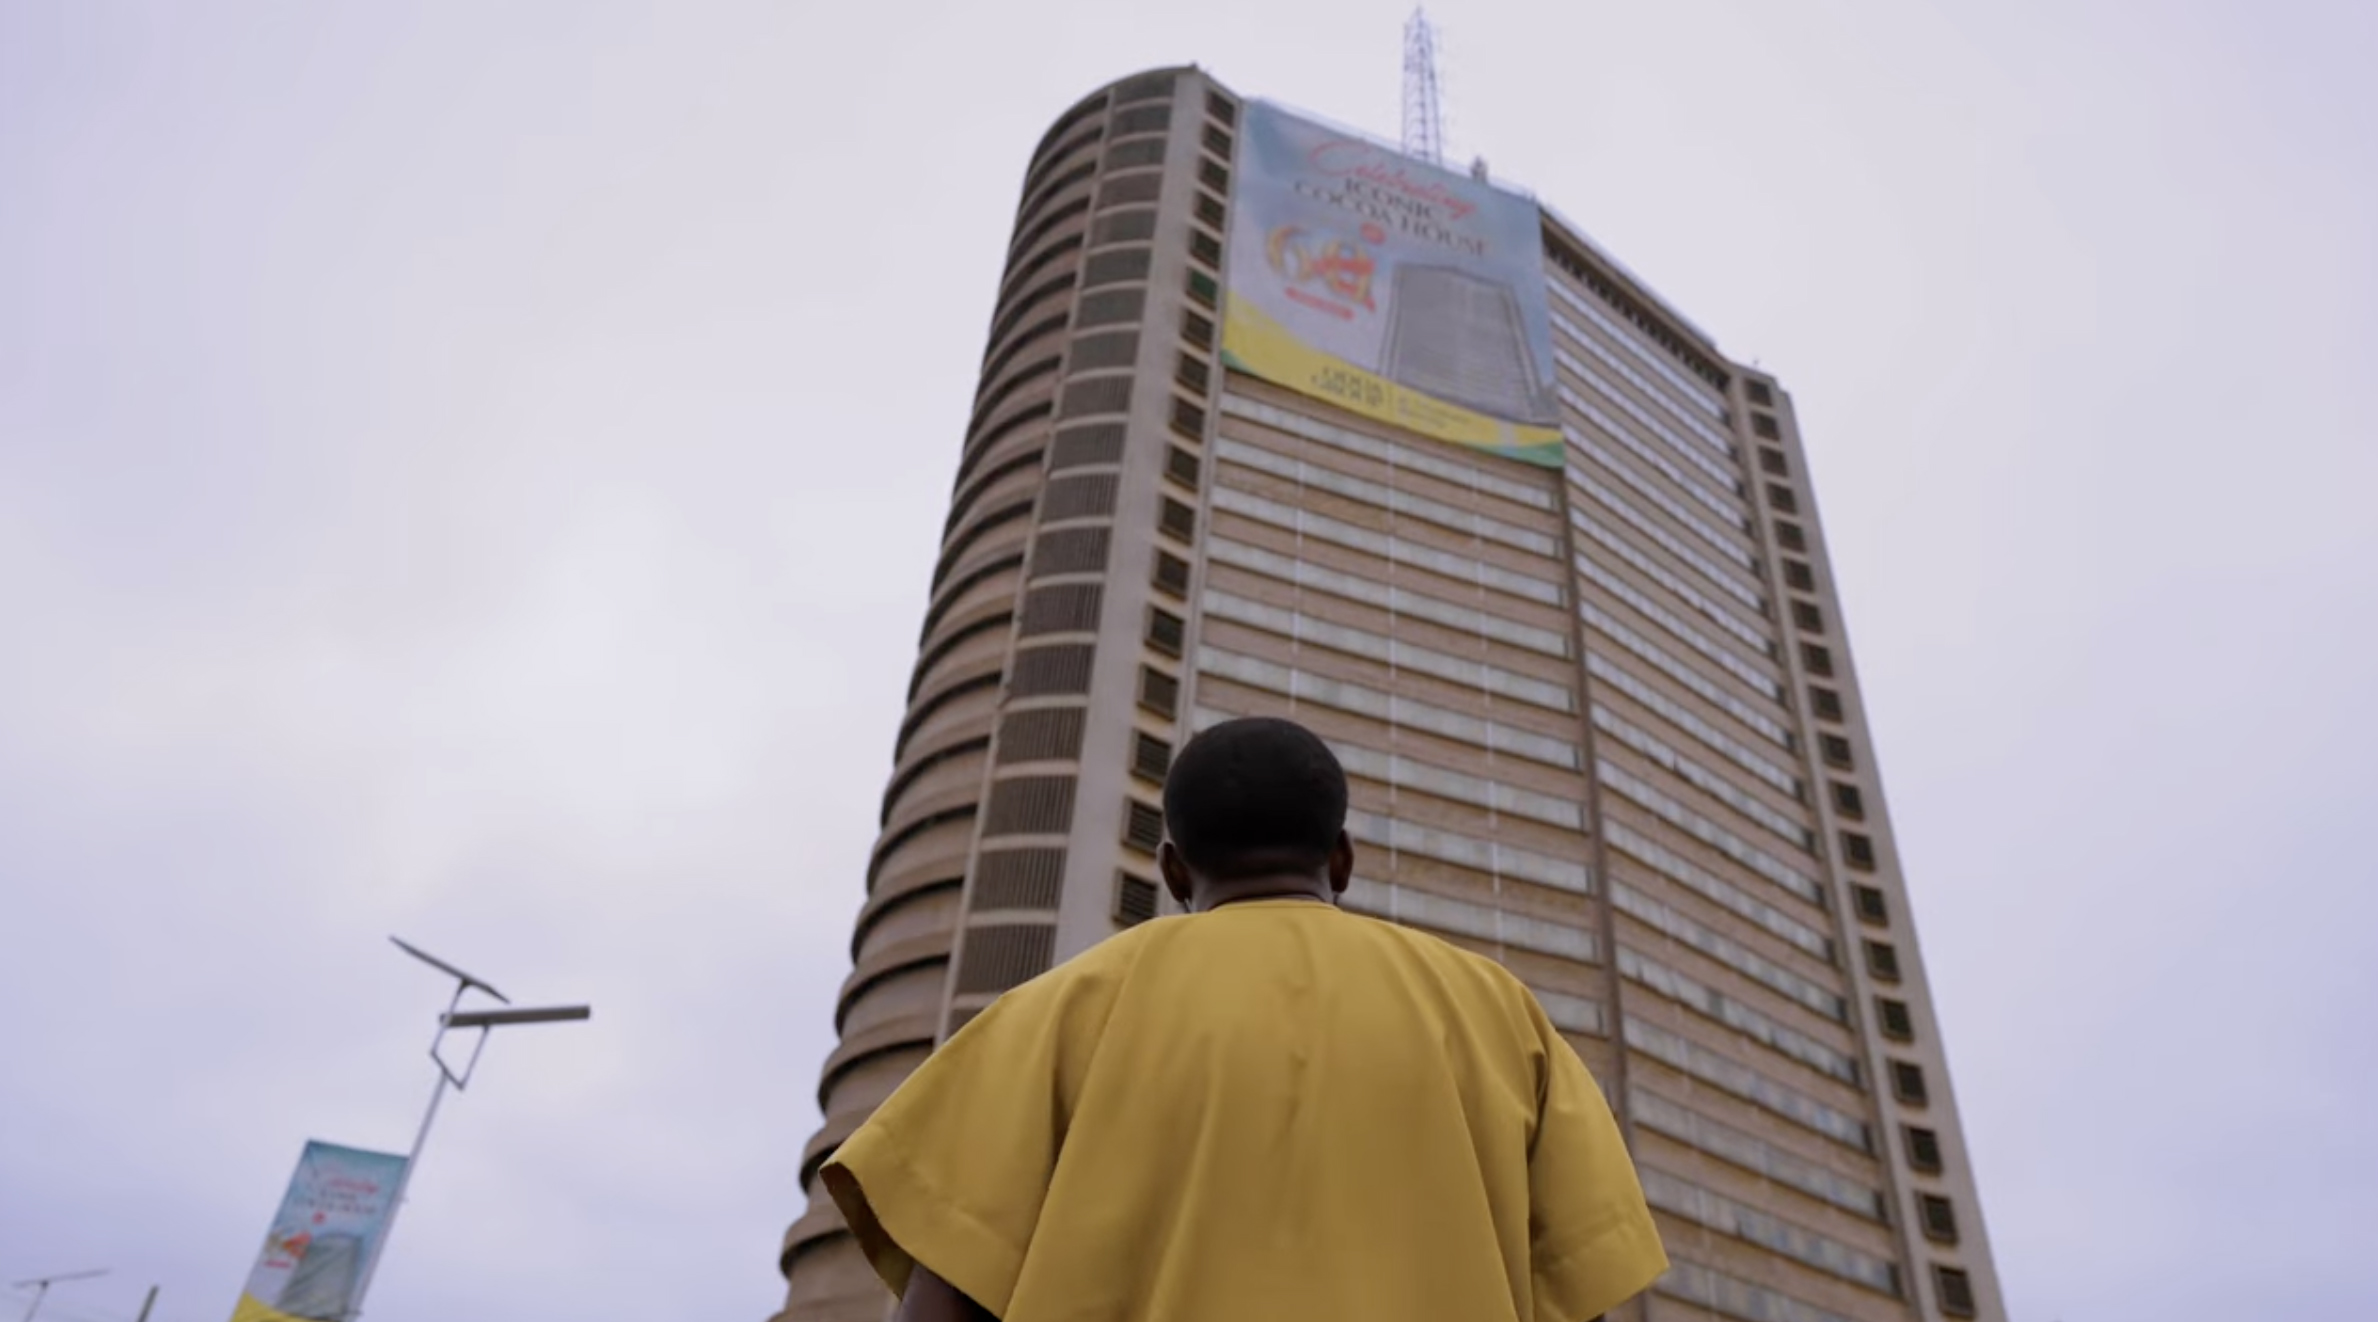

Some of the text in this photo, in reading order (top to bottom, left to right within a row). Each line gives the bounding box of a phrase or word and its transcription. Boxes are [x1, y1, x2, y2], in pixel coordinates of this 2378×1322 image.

[1294, 181, 1392, 226] COCOA
[1402, 216, 1487, 256] HOUSE
[1310, 142, 1475, 220] Celebrating
[1345, 178, 1437, 220] ICONIC
